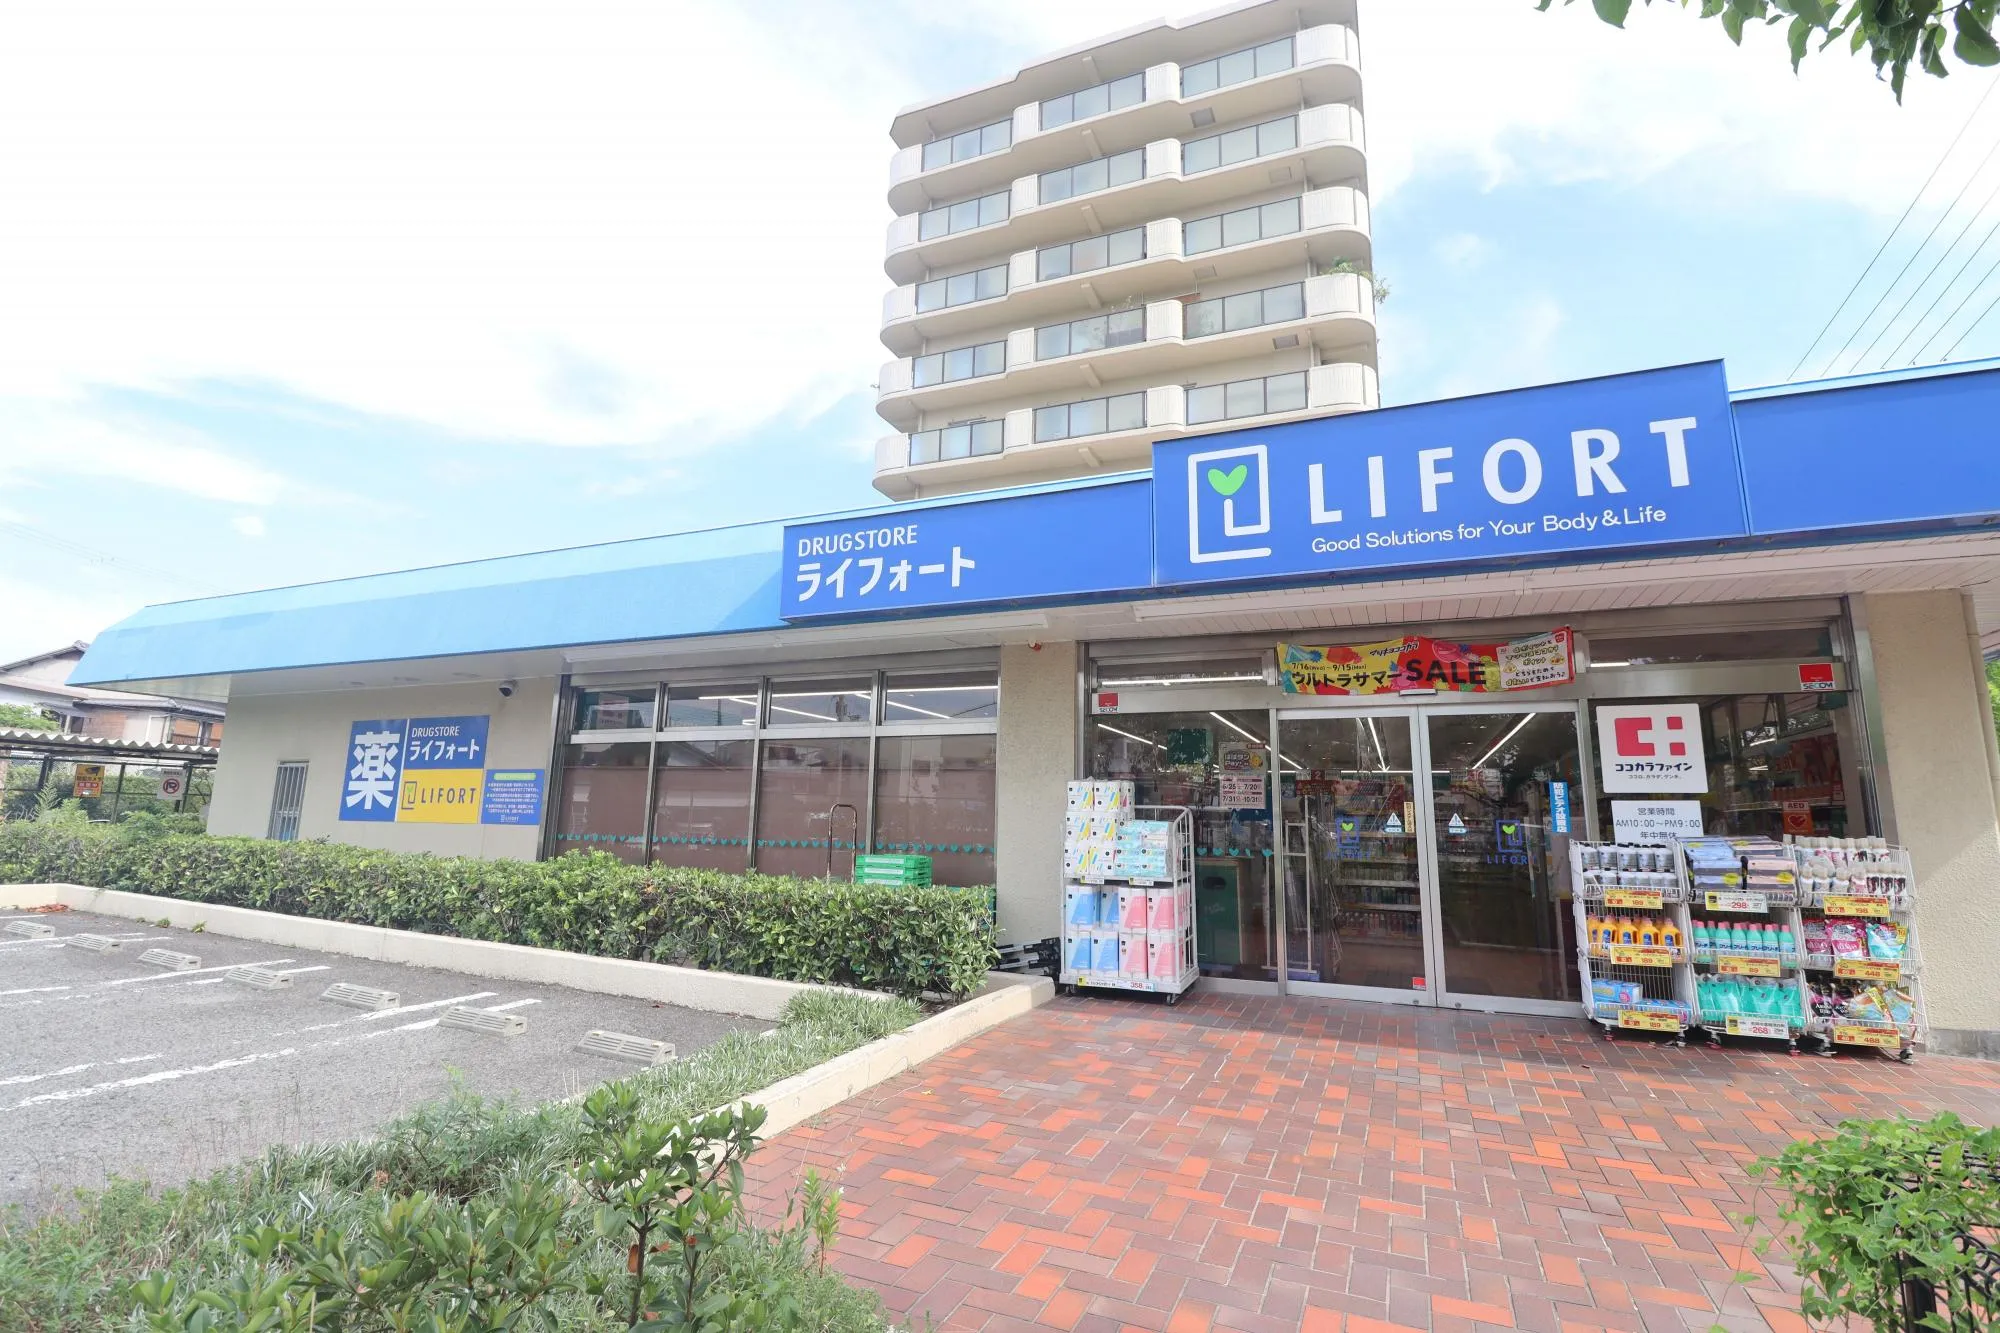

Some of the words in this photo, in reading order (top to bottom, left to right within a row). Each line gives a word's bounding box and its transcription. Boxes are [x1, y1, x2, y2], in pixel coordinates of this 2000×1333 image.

[1308, 416, 1698, 525] LIFORT
[1311, 533, 1361, 553] Good
[1365, 529, 1454, 548] Solutions
[1457, 523, 1483, 540] for
[1489, 519, 1536, 537] Your
[1543, 512, 1598, 531] Body
[1624, 506, 1667, 525] Life
[797, 524, 918, 558] DRUGSTORE
[796, 546, 976, 602] ライフォート
[1291, 671, 1403, 688] ウルトラサマー
[1406, 659, 1487, 685] SALE
[1802, 682, 1834, 690] SECOM
[411, 725, 461, 738] DRUGSTORE
[409, 738, 480, 762] ライフォート
[345, 730, 401, 810] 薬
[1615, 762, 1693, 772] ココカラファイン
[420, 787, 478, 804] LIFORT
[1637, 807, 1675, 816] 営業時間
[1640, 831, 1677, 839] 年中無休
[1731, 901, 1748, 909] 298
[1752, 1026, 1769, 1034] 268
